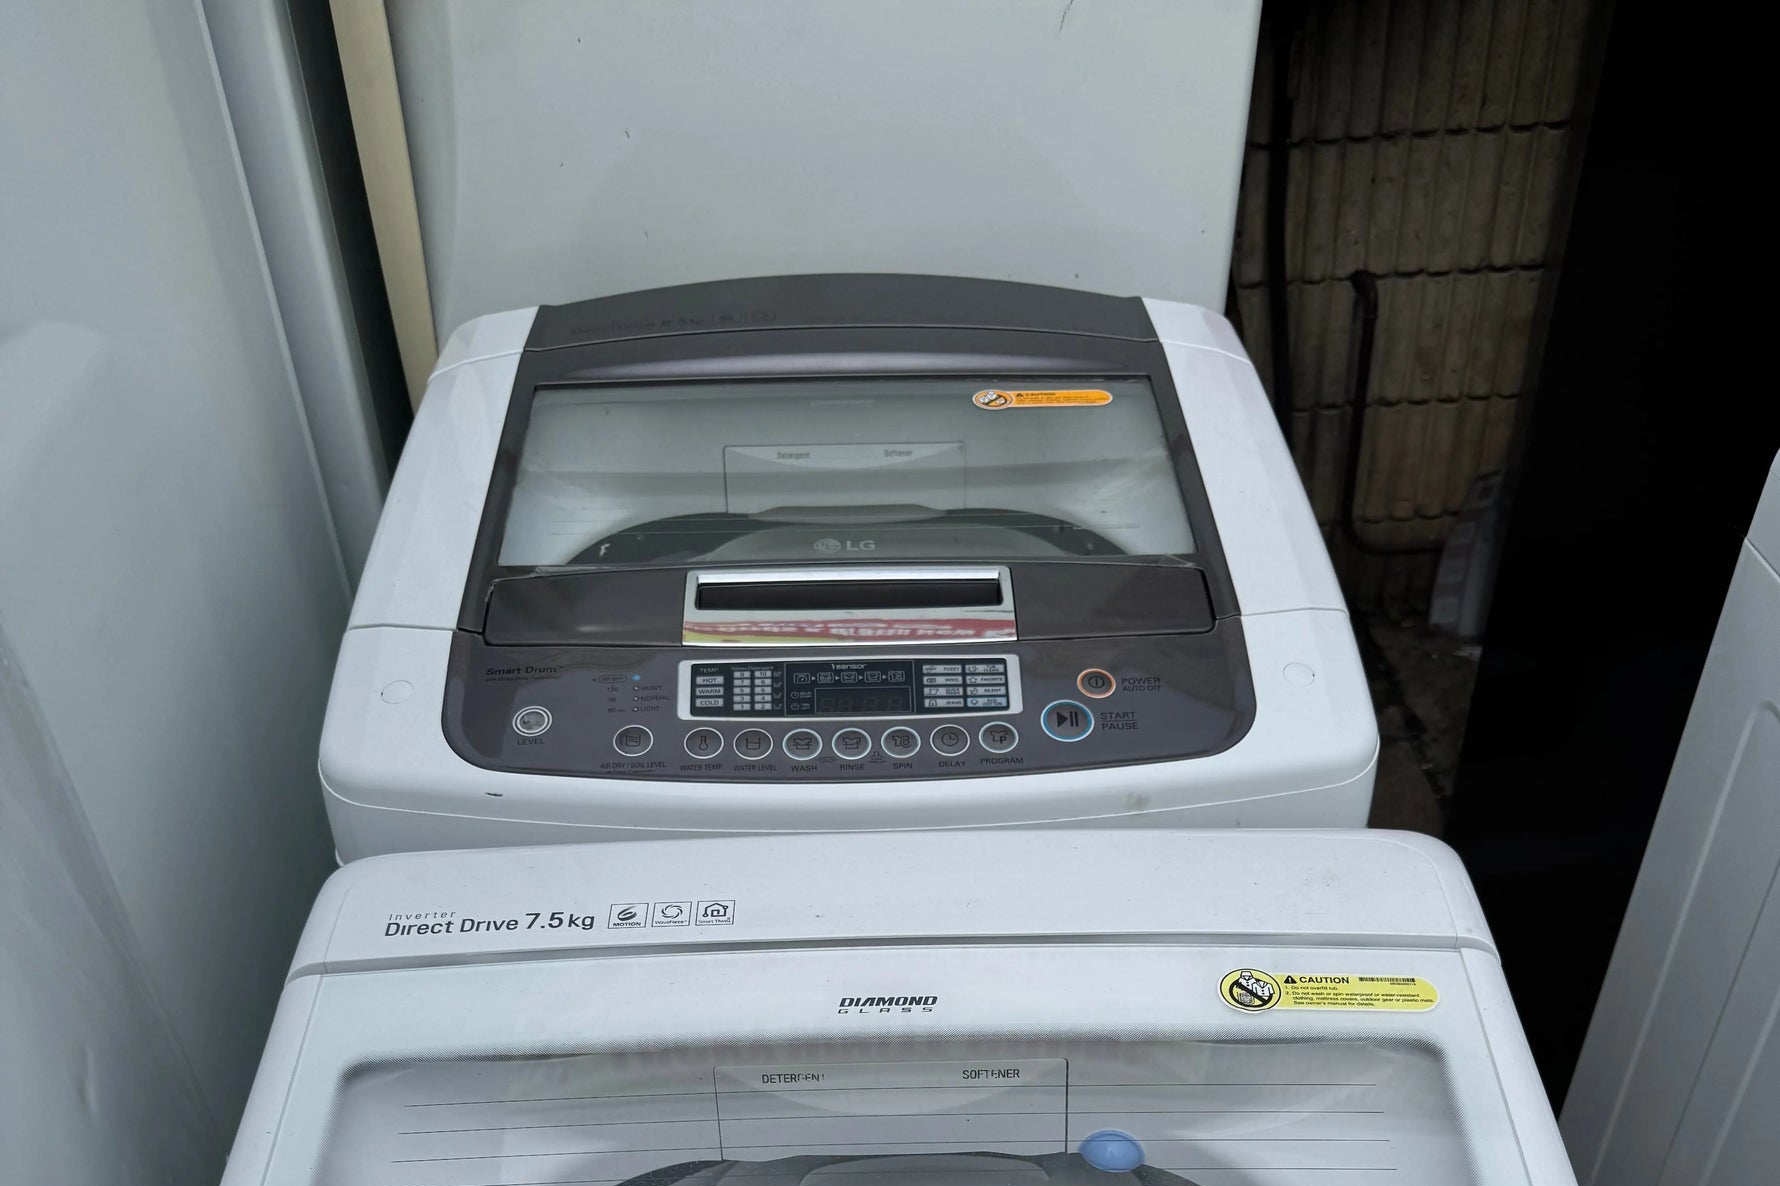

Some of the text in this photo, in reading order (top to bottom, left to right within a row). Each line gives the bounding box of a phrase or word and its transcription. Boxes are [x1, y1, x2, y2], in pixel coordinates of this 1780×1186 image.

[846, 540, 876, 551] LG
[486, 667, 521, 676] Smart
[1121, 677, 1160, 685] POWER
[1100, 711, 1135, 720] START
[1101, 722, 1139, 730] PAUSE
[517, 738, 545, 746] LEVEL
[939, 760, 966, 768] DELAY
[980, 757, 1024, 766] PROGRAM
[680, 764, 702, 772] WATER
[758, 764, 777, 772] LEVEL
[791, 764, 817, 772] WASH
[893, 762, 913, 770] SPIN
[388, 910, 457, 921] Inverter
[384, 920, 455, 937] Direct
[459, 917, 519, 934] Drive
[1300, 976, 1350, 984] CAUTION
[839, 996, 938, 1007] DIAMOND
[762, 1073, 824, 1084] DETERGEN
